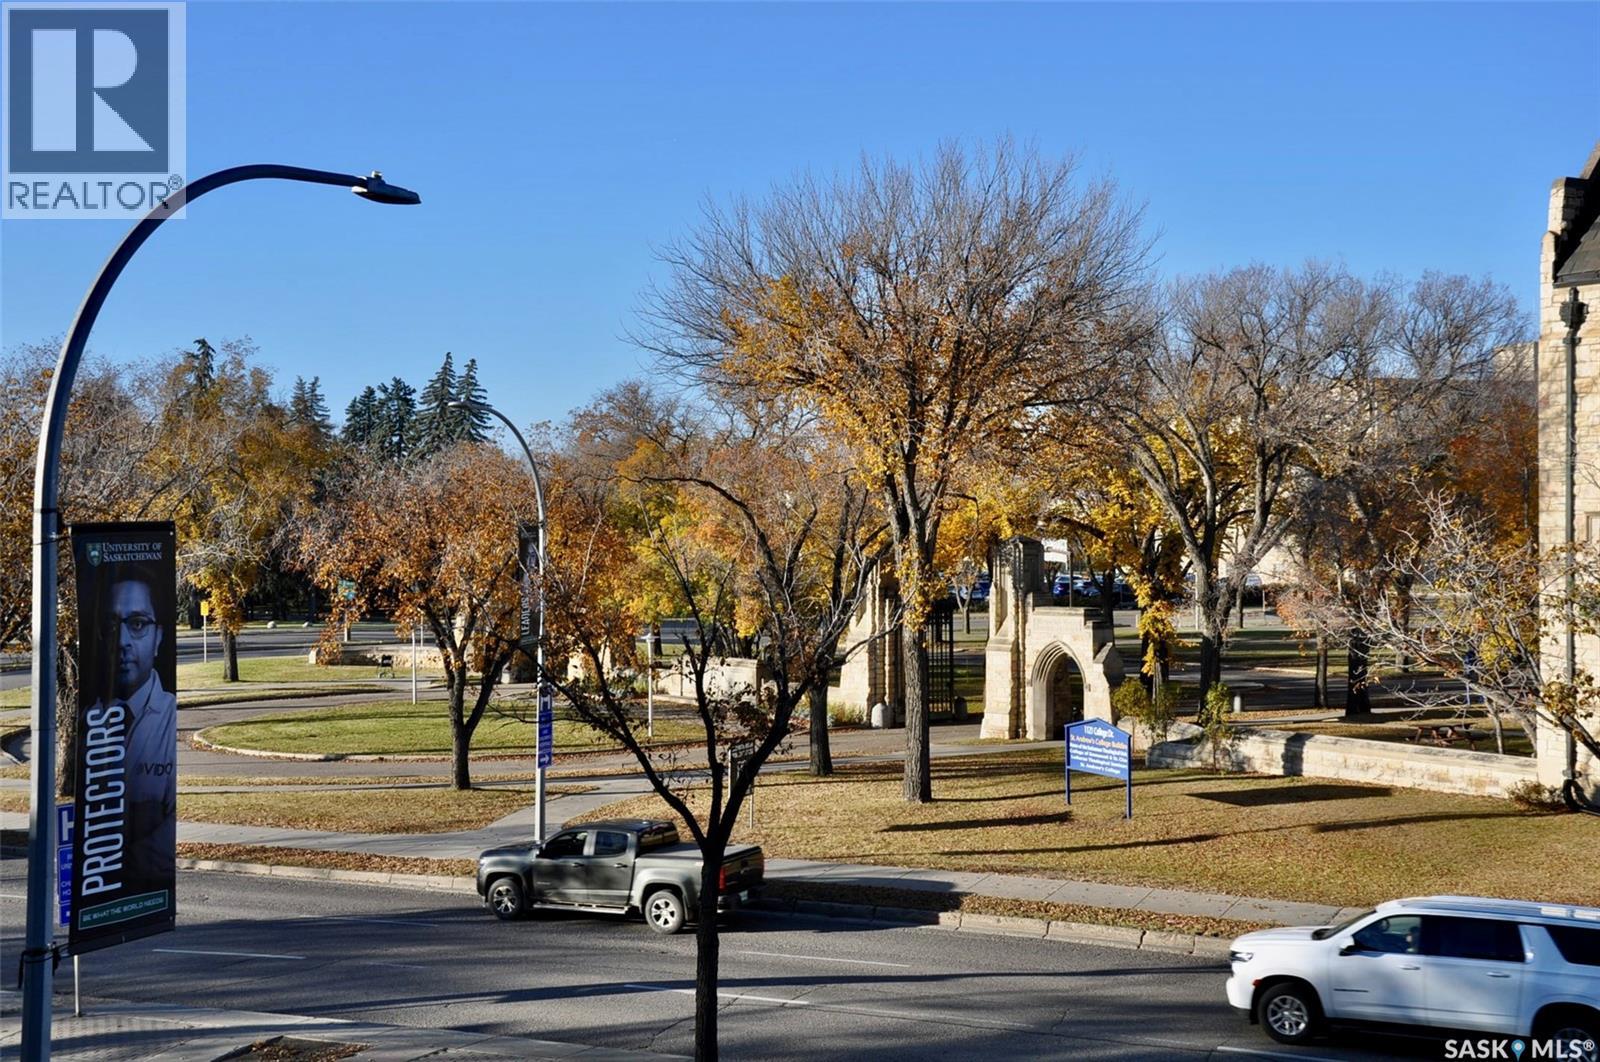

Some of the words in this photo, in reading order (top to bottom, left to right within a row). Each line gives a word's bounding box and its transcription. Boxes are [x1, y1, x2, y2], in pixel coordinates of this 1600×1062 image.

[102, 542, 150, 552] UNIVERSITY
[152, 542, 162, 551] OF
[103, 551, 162, 562] SASKATCHEWAN
[81, 705, 126, 896] PROTECTORS
[122, 901, 144, 912] WORLD
